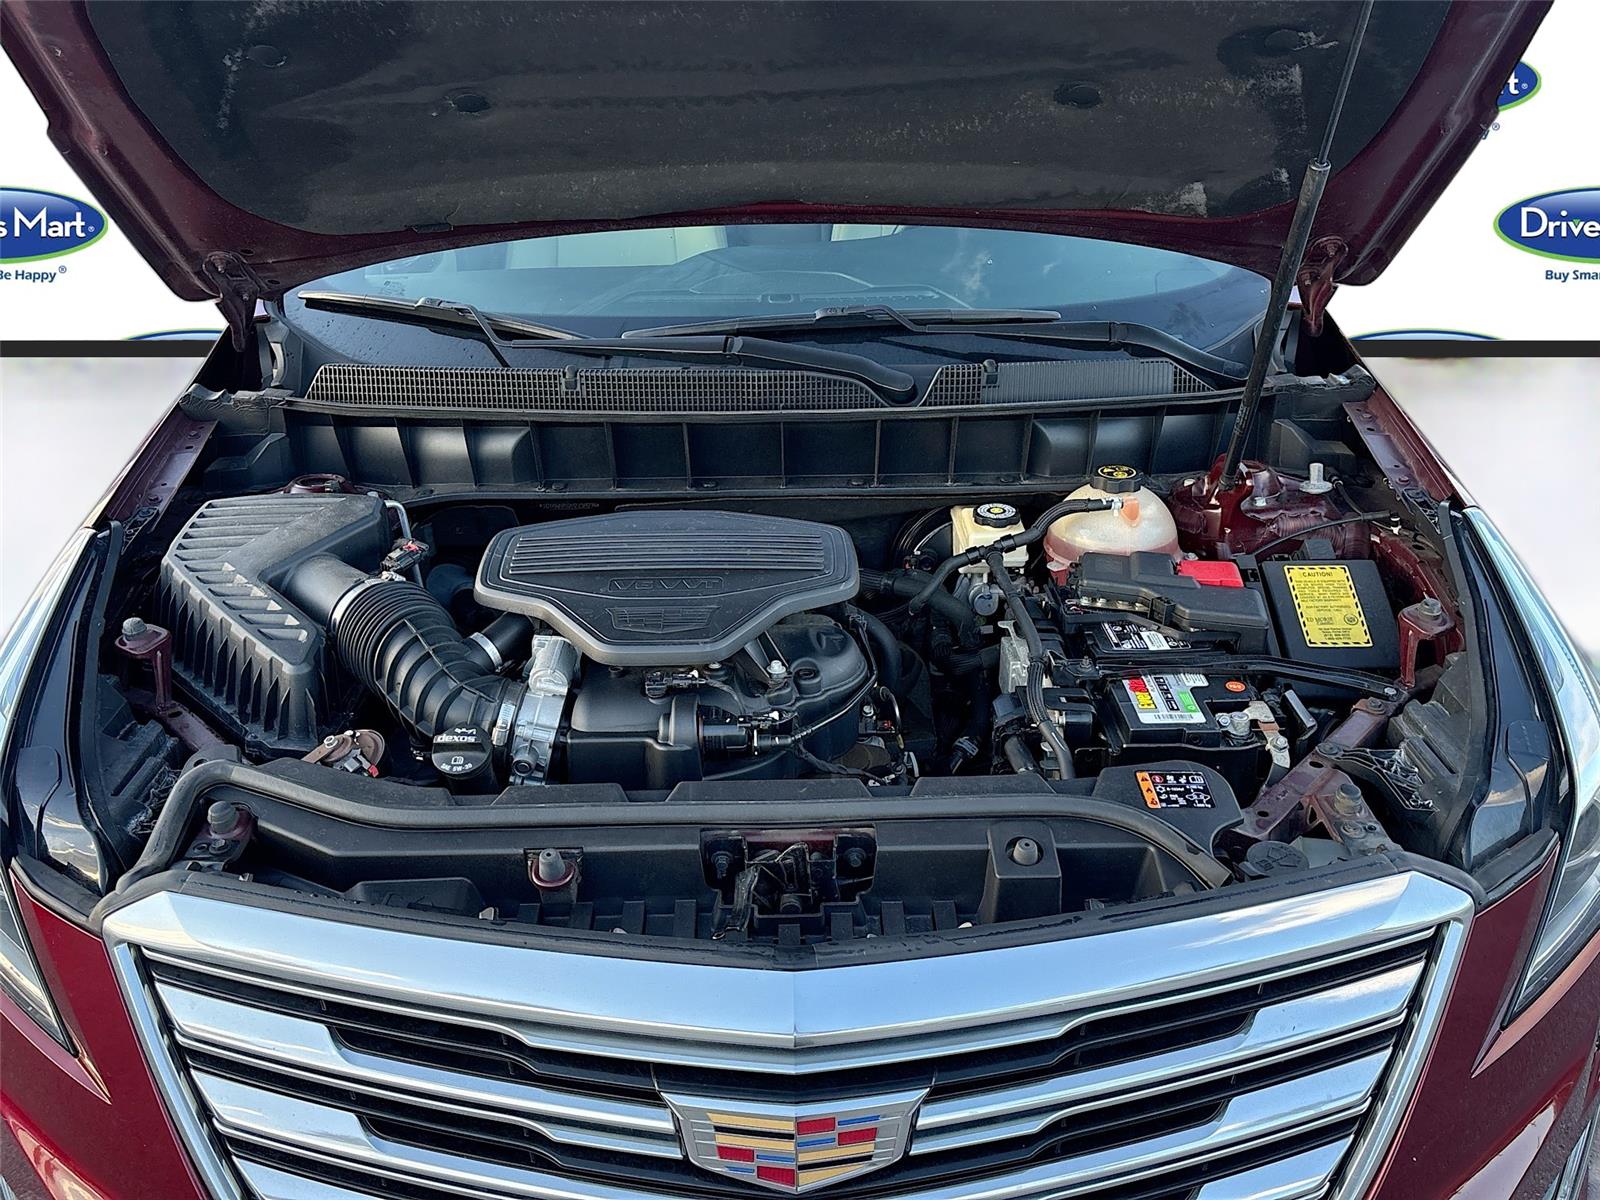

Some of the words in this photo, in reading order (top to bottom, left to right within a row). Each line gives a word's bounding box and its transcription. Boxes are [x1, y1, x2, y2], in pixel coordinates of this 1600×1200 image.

[14, 206, 86, 238] Mart
[15, 270, 57, 283] Happy
[1545, 269, 1570, 283] Buy
[613, 579, 653, 590] V6
[437, 733, 477, 742] dexos
